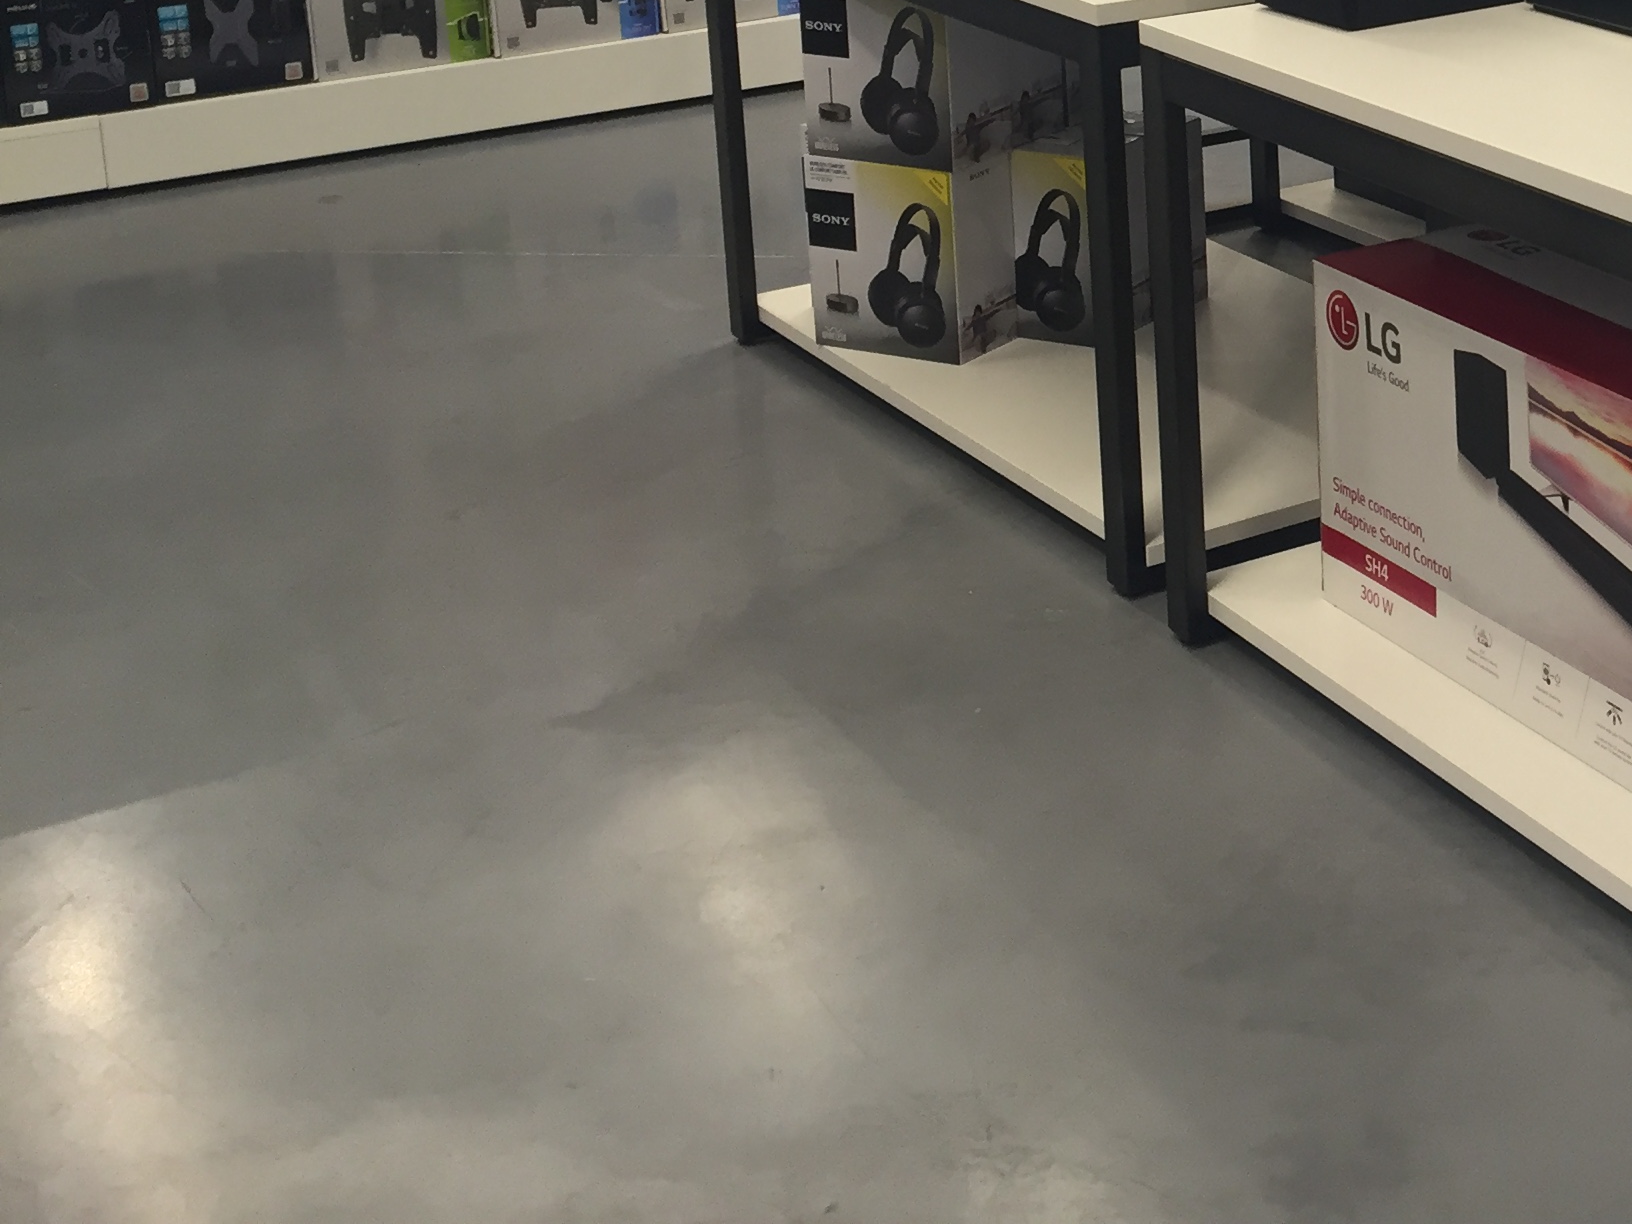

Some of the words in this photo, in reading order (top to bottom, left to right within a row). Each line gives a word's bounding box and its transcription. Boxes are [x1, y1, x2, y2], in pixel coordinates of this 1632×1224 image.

[804, 20, 843, 33] SONY
[812, 213, 850, 226] SONY
[1364, 311, 1401, 365] LG
[1367, 360, 1387, 383] Life's
[1388, 371, 1410, 392] Good
[1332, 476, 1366, 505] Simple
[1368, 499, 1425, 543] connection,
[1333, 502, 1377, 538] Adaptive
[1379, 526, 1411, 559] Sound
[1413, 546, 1453, 582] Control
[1364, 554, 1389, 582] SH4
[1360, 584, 1380, 609] 300
[1382, 597, 1394, 616] W
